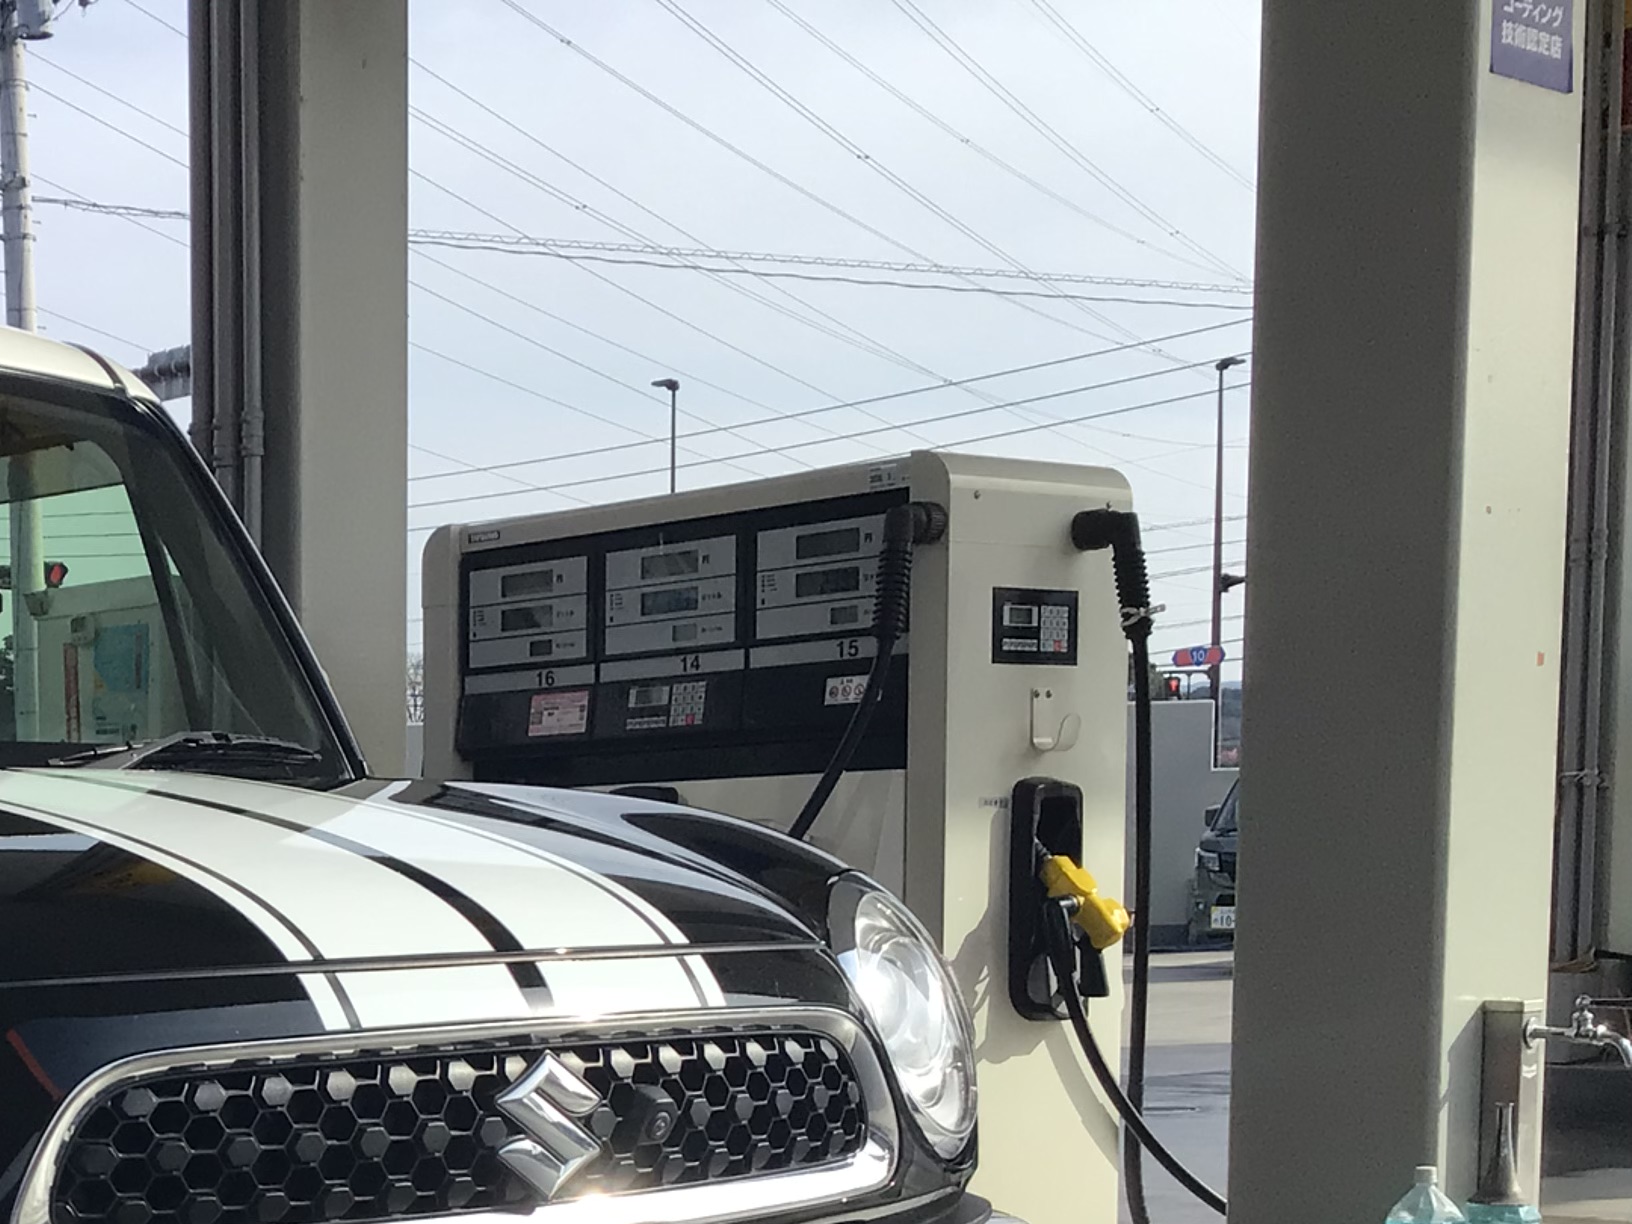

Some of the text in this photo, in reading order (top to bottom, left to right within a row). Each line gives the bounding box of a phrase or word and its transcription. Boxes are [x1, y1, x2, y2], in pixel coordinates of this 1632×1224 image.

[836, 640, 859, 658] 15
[1192, 649, 1205, 663] 10
[680, 655, 701, 672] 14
[536, 671, 555, 687] 16
